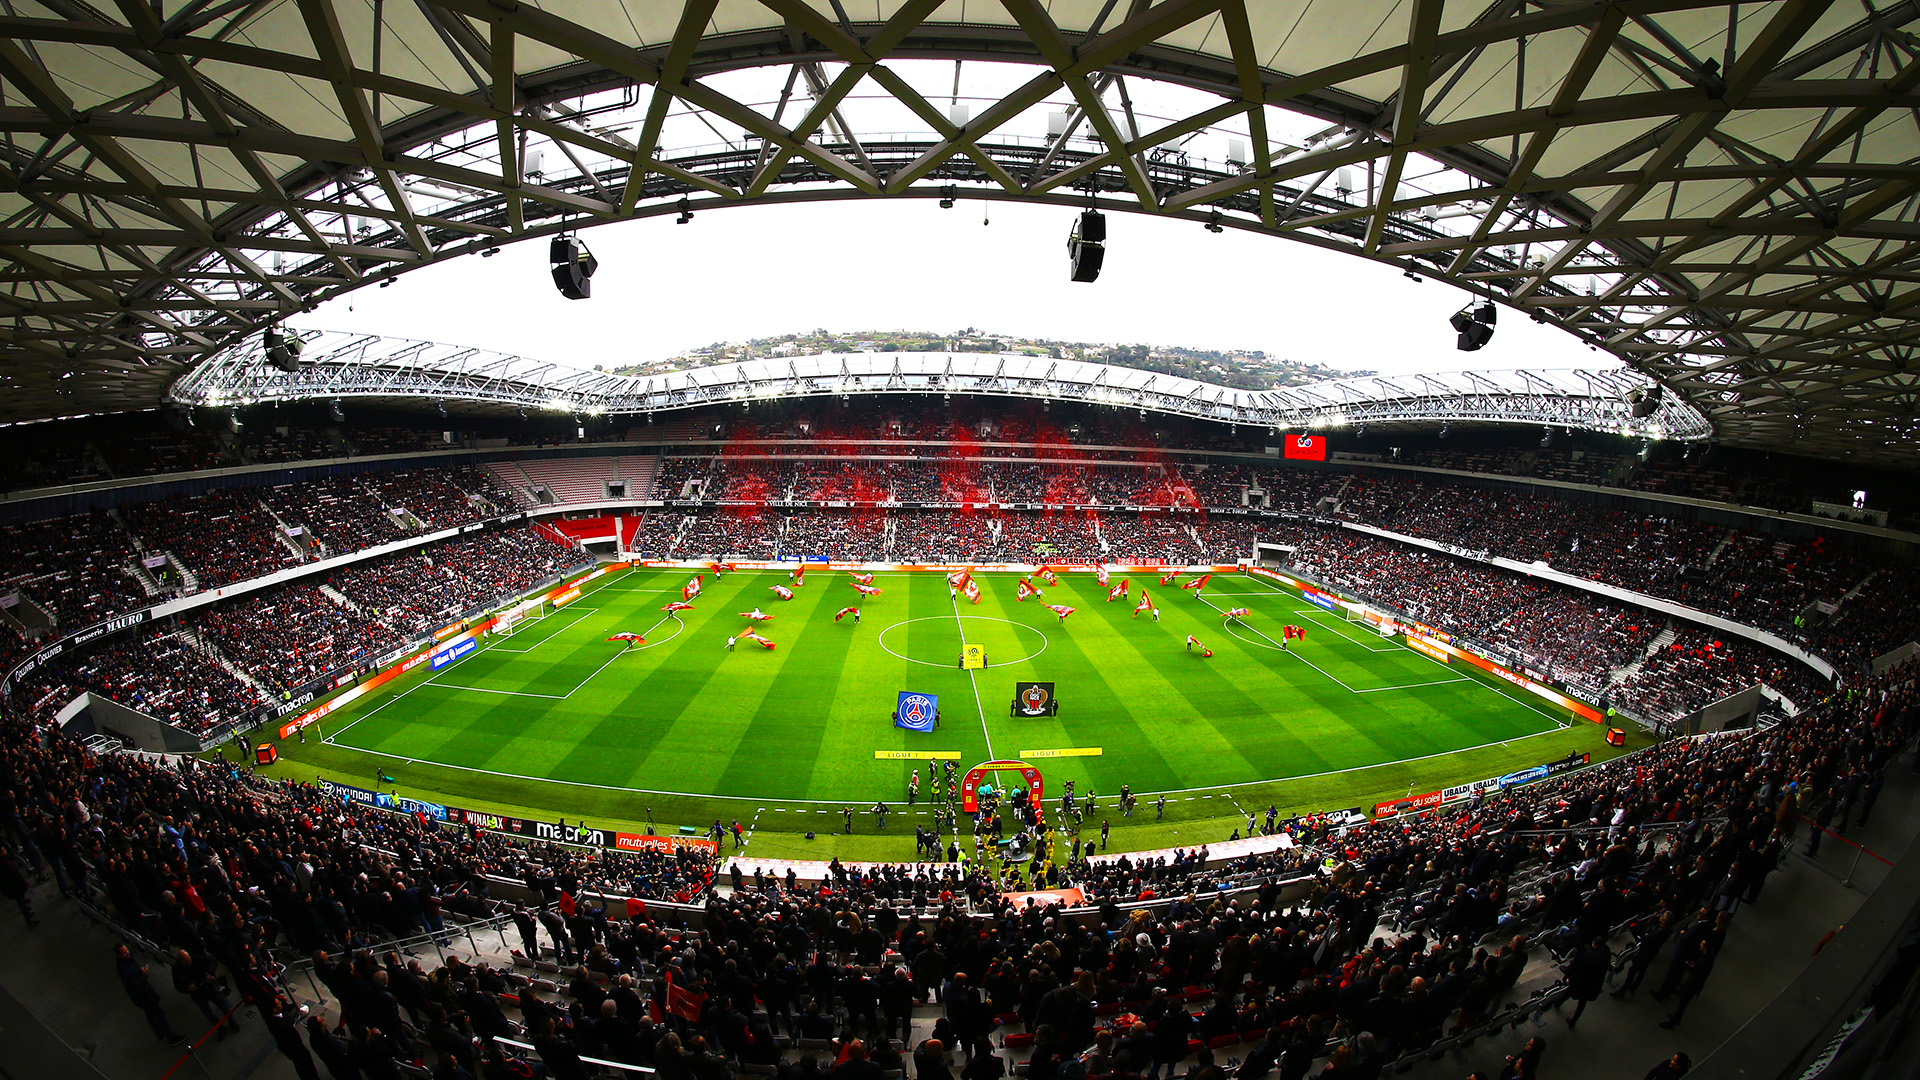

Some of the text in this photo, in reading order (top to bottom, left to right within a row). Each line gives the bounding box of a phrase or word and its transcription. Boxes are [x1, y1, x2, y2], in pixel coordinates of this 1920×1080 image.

[74, 612, 143, 645] Brasserie MAURO
[378, 642, 417, 664] UBALDI UBALDI
[402, 648, 437, 672] mutuelles du
[1486, 651, 1505, 663] UBALDI
[1491, 667, 1526, 688] mutuelles du
[277, 691, 314, 716] macron
[906, 696, 928, 707] PARIS
[1565, 684, 1600, 707] macron
[287, 712, 318, 735] muuelles
[317, 704, 329, 718] du
[336, 786, 373, 803] HYUNDAI
[1443, 777, 1498, 798] UBALDI UBALDI
[423, 804, 444, 818] NICE
[1413, 793, 1441, 808] du soleil
[466, 811, 504, 830] WINAAX
[619, 837, 668, 851] mutuelles
